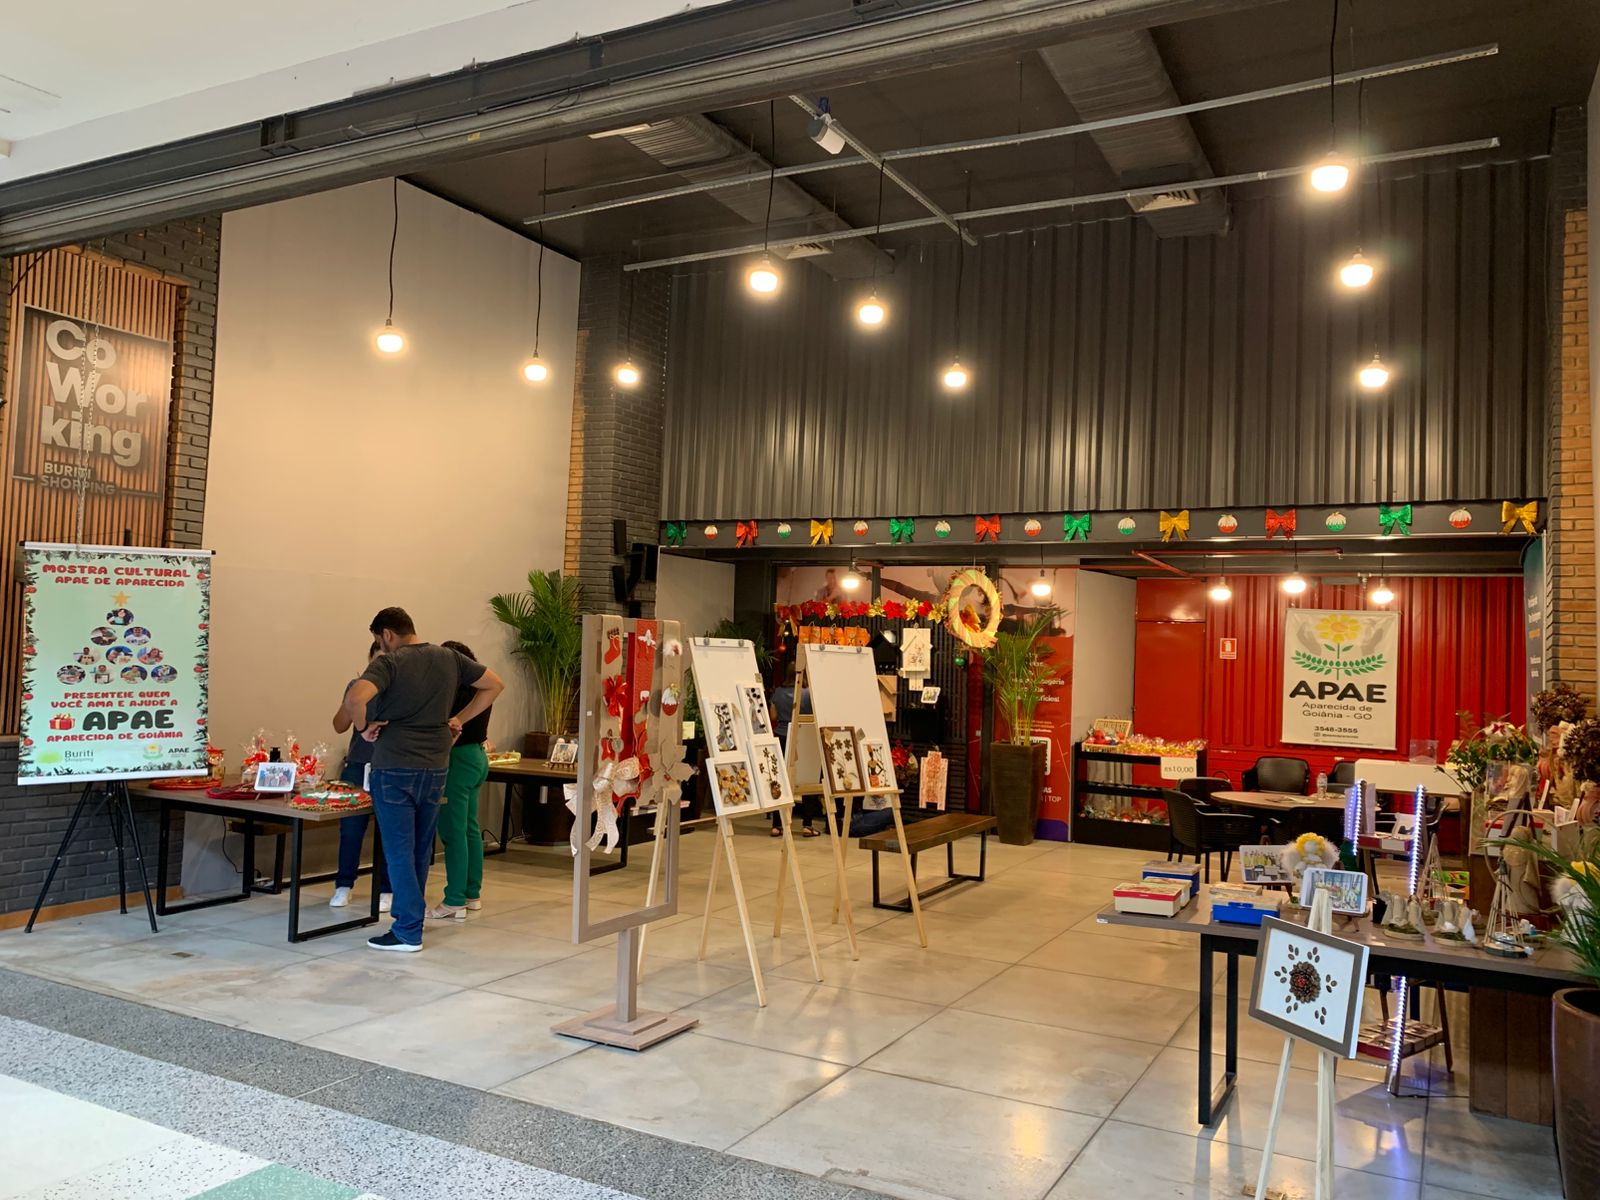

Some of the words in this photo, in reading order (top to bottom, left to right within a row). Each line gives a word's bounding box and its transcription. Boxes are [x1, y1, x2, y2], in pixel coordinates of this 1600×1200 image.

[46, 320, 117, 369] Co
[46, 361, 152, 417] Wor
[41, 405, 142, 467] king
[44, 462, 92, 479] BURITI
[40, 475, 116, 495] SHOPPING
[42, 564, 108, 575] MOSTRA
[114, 566, 191, 578] CULTURAL
[55, 576, 89, 585] APAE
[94, 577, 111, 585] DE
[115, 578, 185, 587] APARECIDA
[64, 691, 134, 699] PRESENTEIE
[138, 691, 171, 699] QUEM
[1289, 680, 1387, 704] APAE
[50, 700, 83, 708] VOCÊ
[87, 700, 114, 708] AMA
[129, 699, 168, 707] AJUDE
[1302, 702, 1356, 712] Aparecida
[82, 709, 175, 731] APAE
[1302, 709, 1343, 719] Goiânia
[1353, 713, 1373, 721] GO
[46, 733, 114, 743] APARECIDA
[118, 732, 133, 740] DE
[137, 731, 183, 740] GOIÂNIA
[64, 750, 94, 758] Buriti
